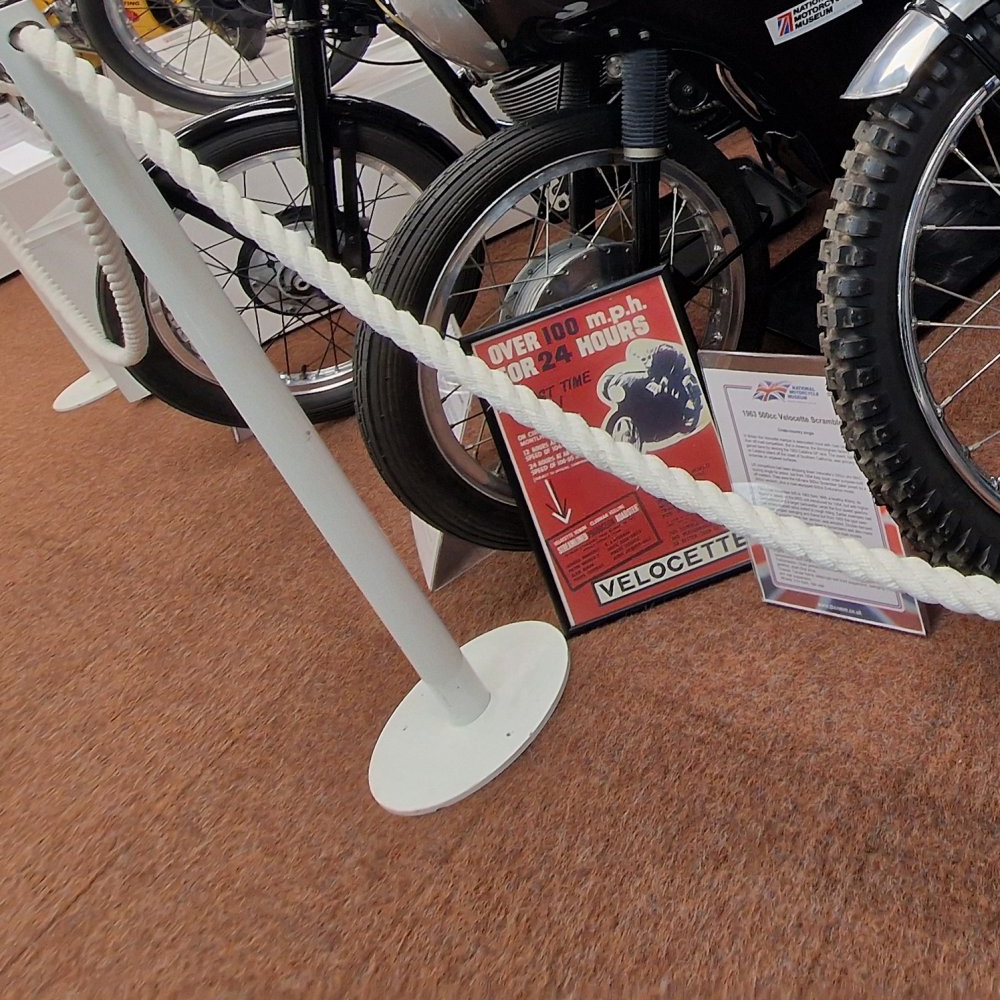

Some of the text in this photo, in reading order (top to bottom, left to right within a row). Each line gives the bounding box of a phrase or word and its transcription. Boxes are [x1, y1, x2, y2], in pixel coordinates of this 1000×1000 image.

[795, 6, 833, 29] MUSEUM
[487, 295, 647, 365] OVER 100 m.p.h.
[502, 314, 650, 383] OR 24 HOURS
[560, 370, 592, 392] TIME
[778, 413, 809, 423] Velocette
[599, 533, 748, 598] VELOCETTE
